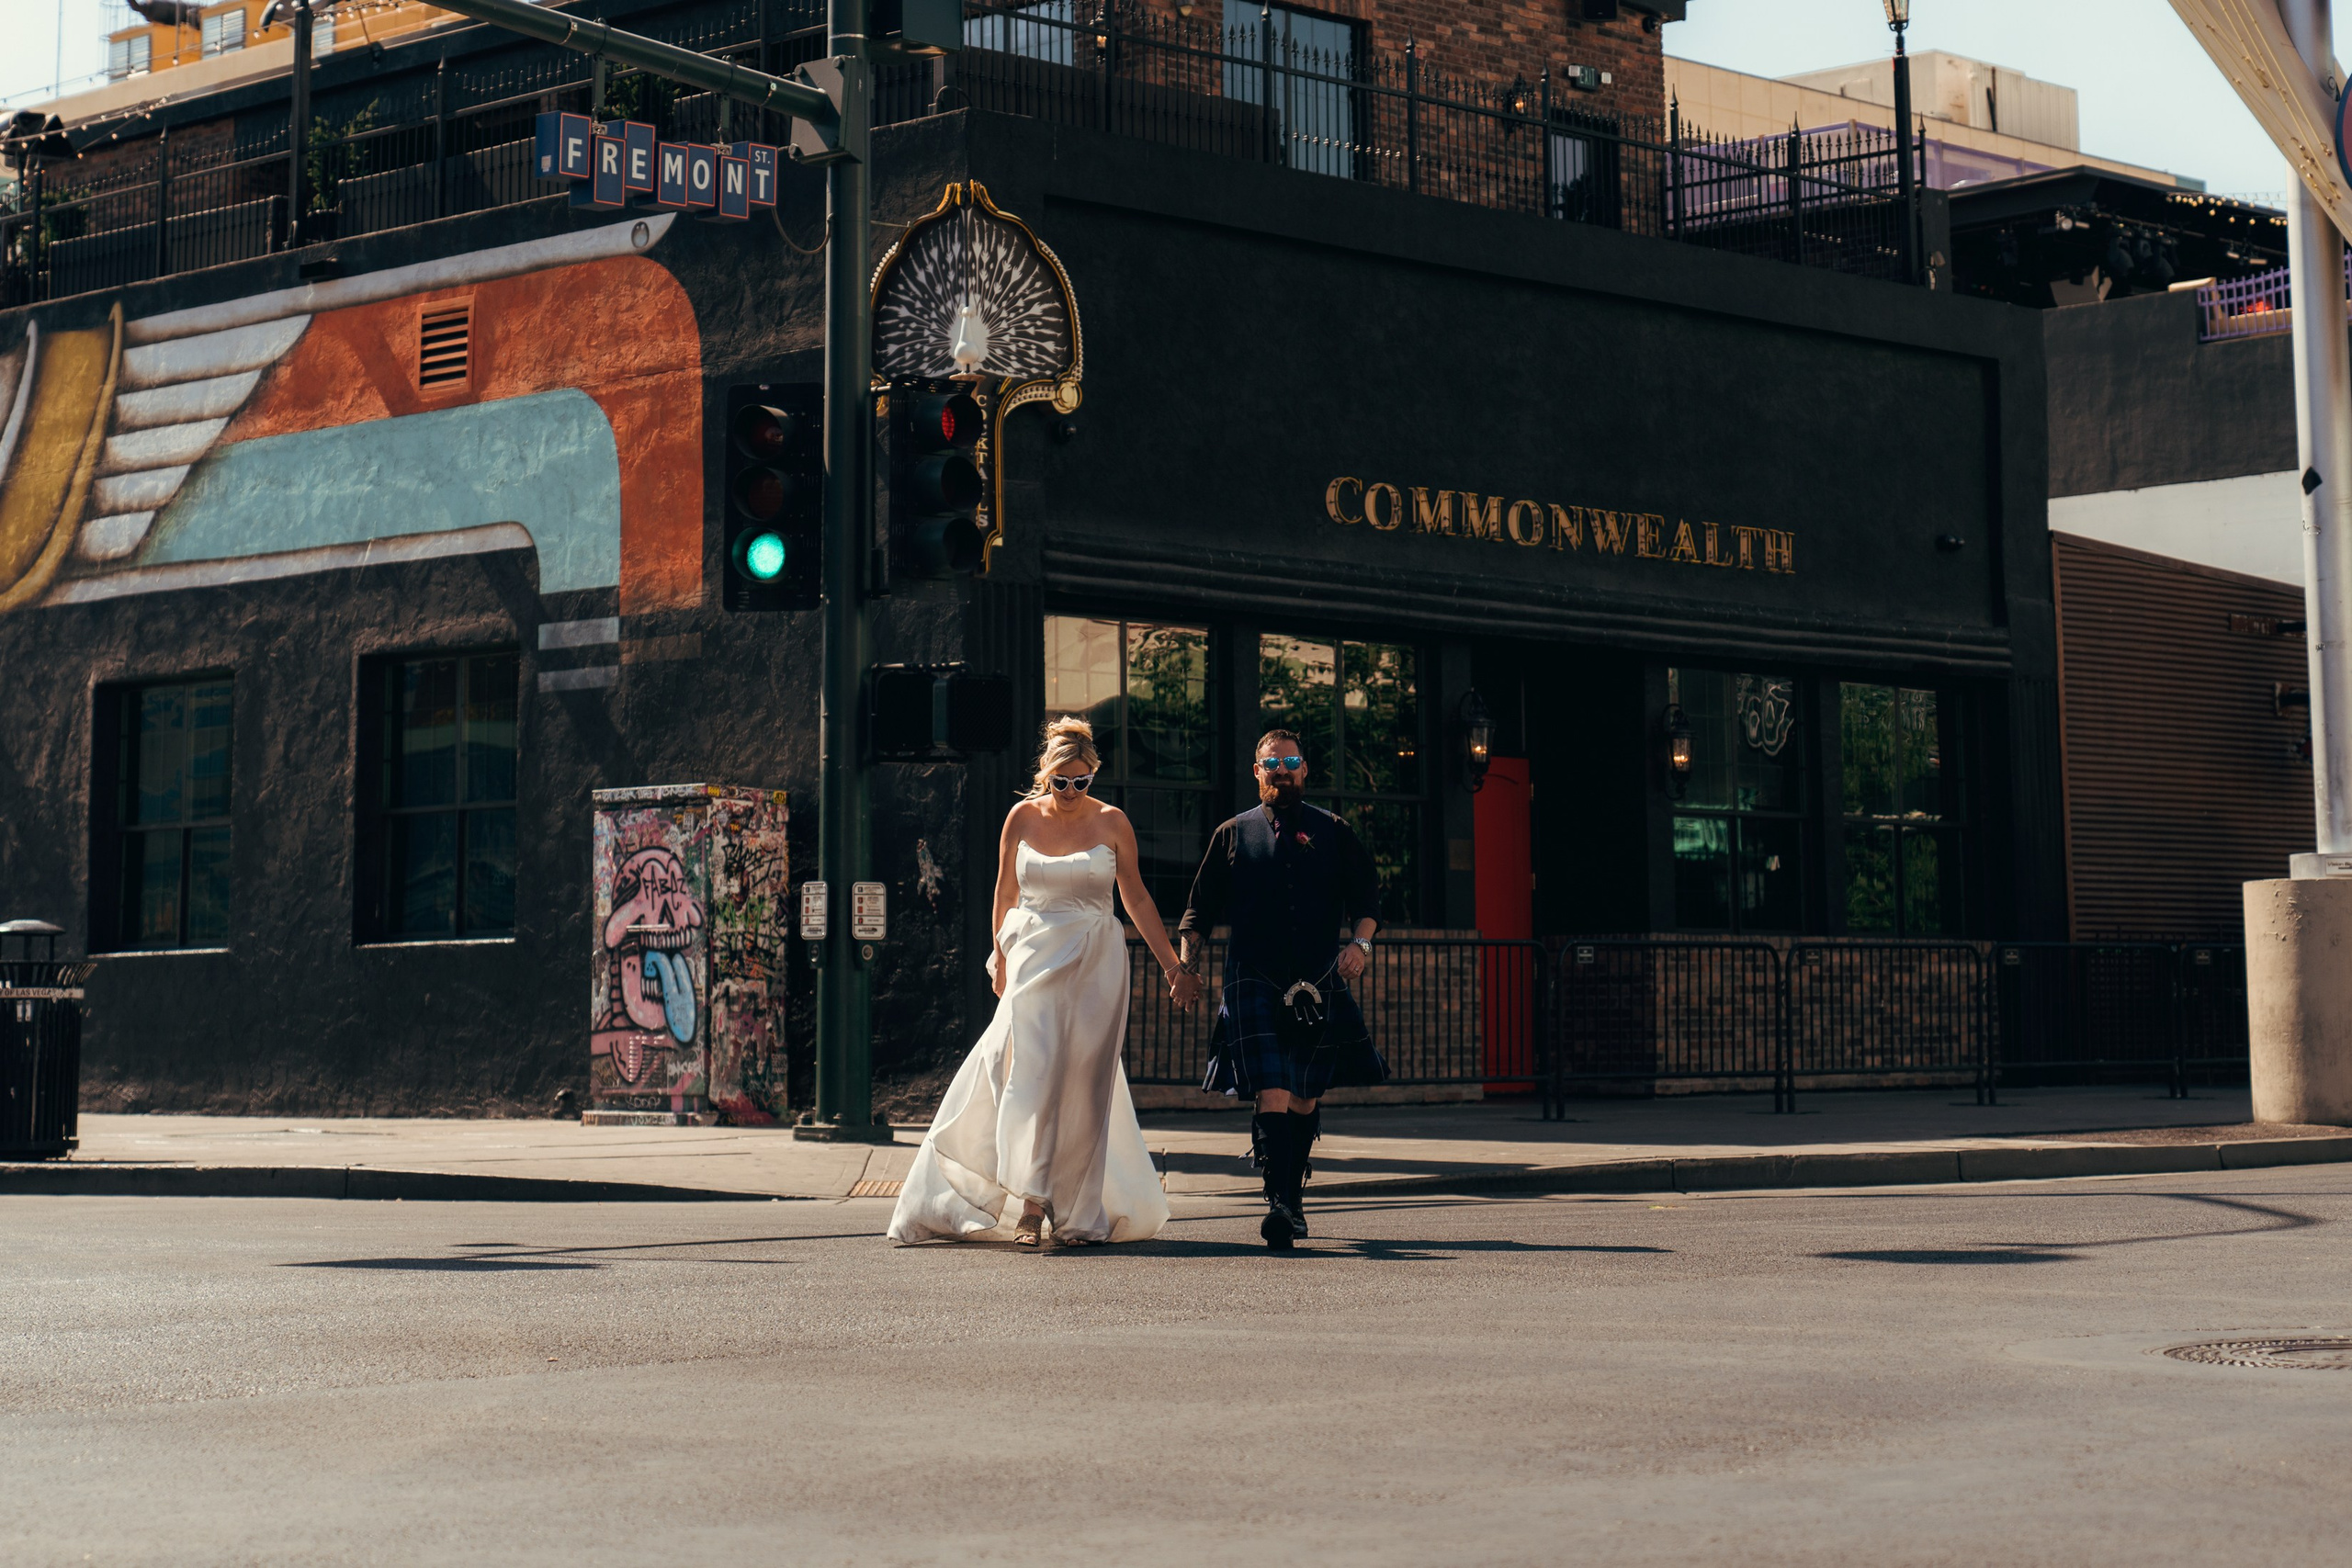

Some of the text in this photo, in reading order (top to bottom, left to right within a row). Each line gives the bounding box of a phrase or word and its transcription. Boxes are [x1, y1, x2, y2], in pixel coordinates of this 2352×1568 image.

[1579, 66, 1596, 86] EXIT
[567, 137, 771, 199] FREMONT ST.
[1325, 476, 1796, 574] COMMONWEALTH
